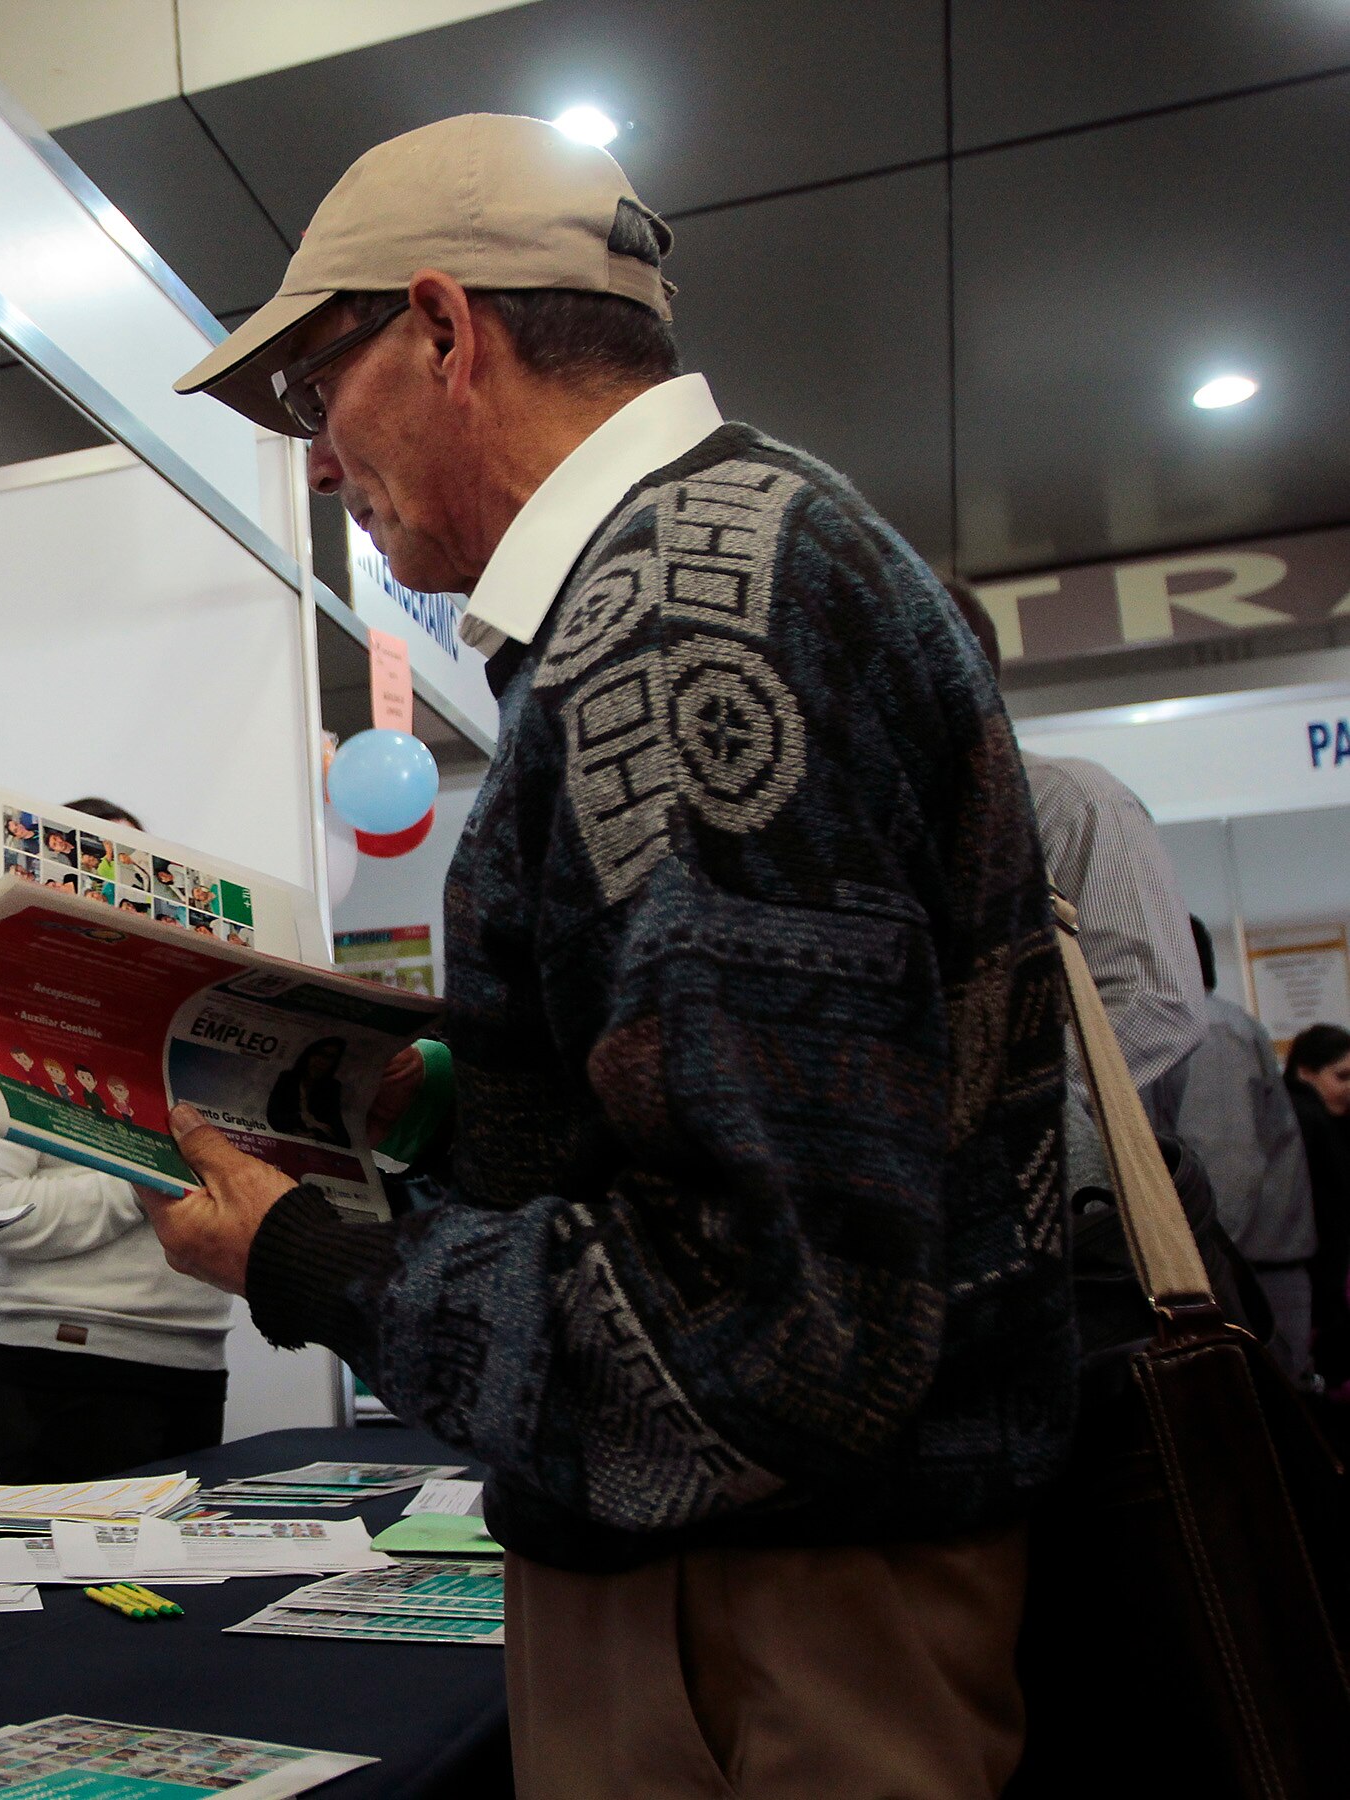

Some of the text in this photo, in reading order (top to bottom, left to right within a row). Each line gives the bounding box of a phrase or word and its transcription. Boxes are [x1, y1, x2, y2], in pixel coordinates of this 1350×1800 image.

[972, 551, 1350, 662] TR
[33, 982, 101, 1008] Recepcionista
[20, 1010, 102, 1038] Auxiliar Contable
[190, 1017, 278, 1054] EMPLEO
[222, 1112, 267, 1131] Gratuito
